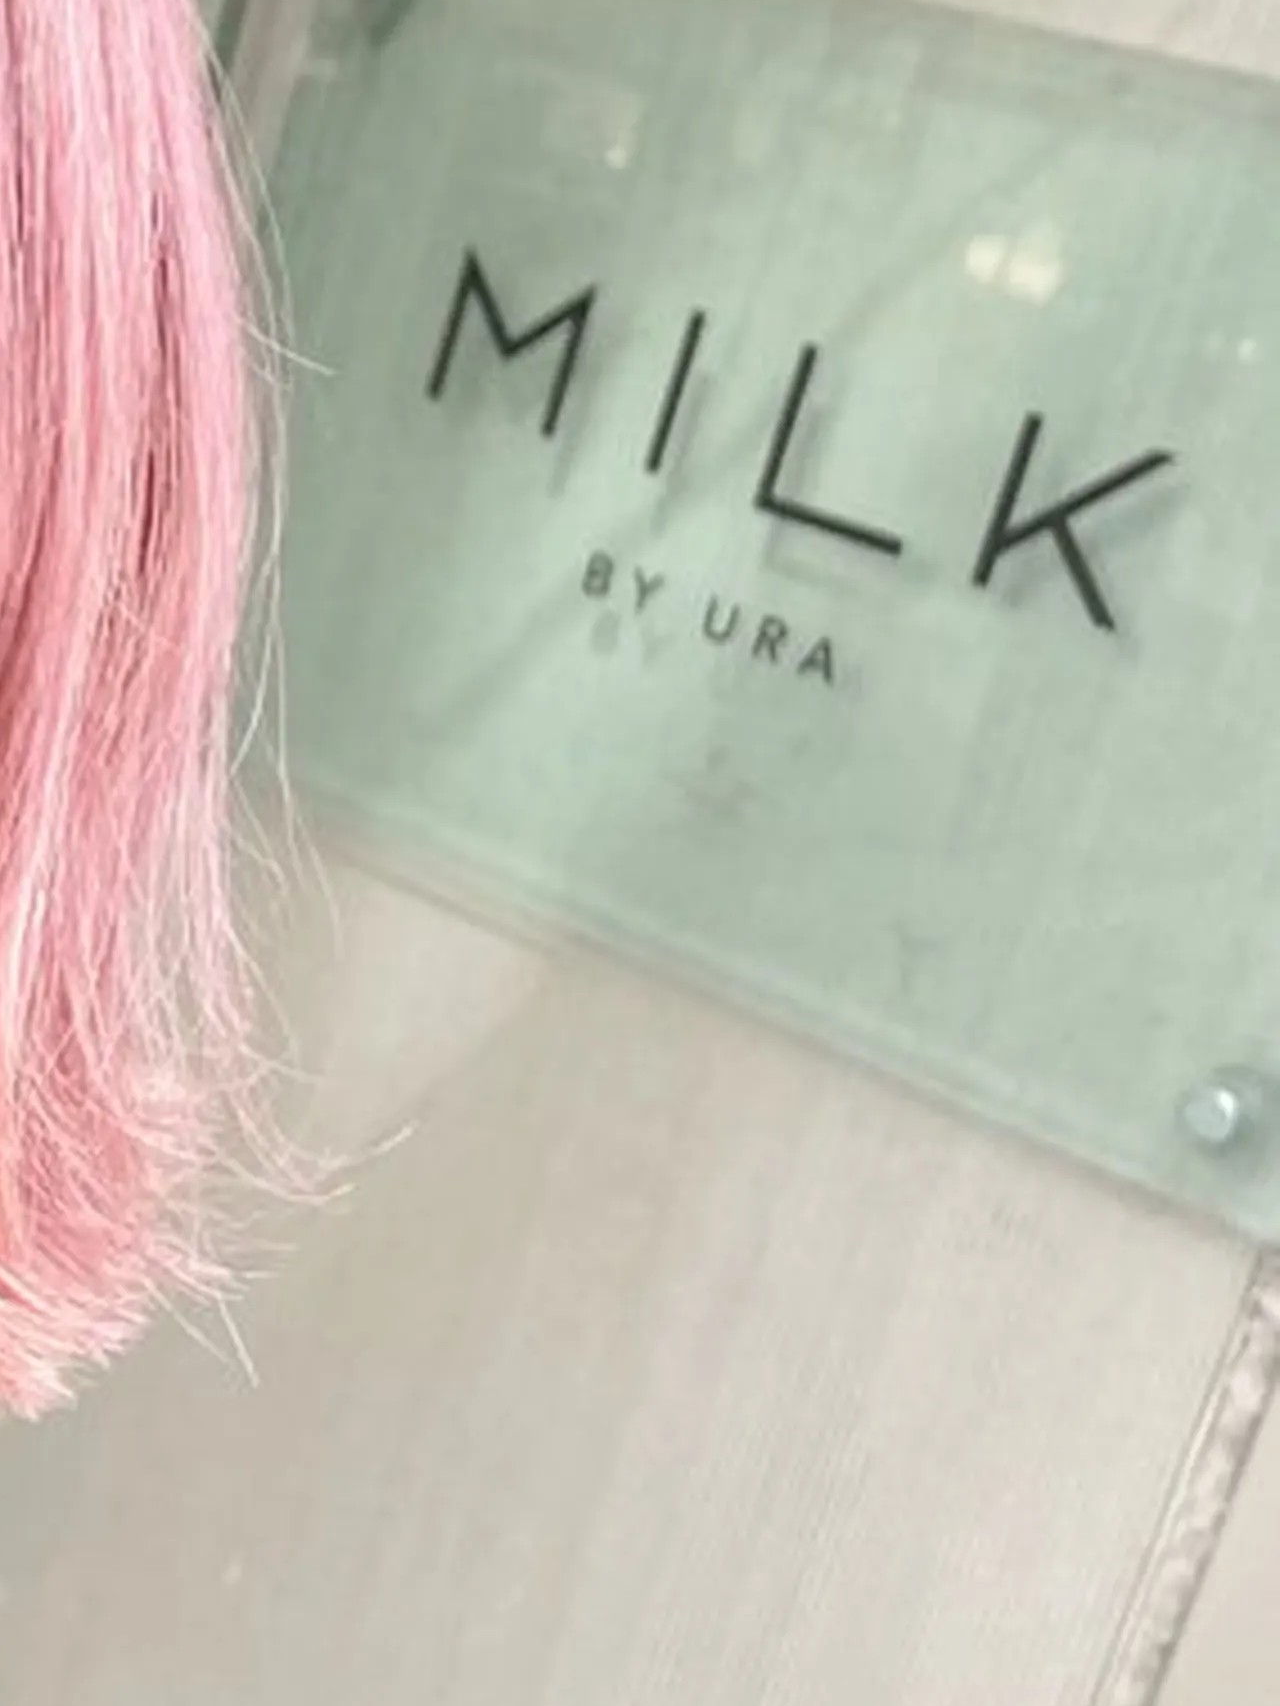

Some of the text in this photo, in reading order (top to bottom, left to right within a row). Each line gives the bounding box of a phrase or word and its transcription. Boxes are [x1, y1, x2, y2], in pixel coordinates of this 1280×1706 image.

[426, 241, 1177, 633] MILK
[581, 549, 837, 687] BY URA
